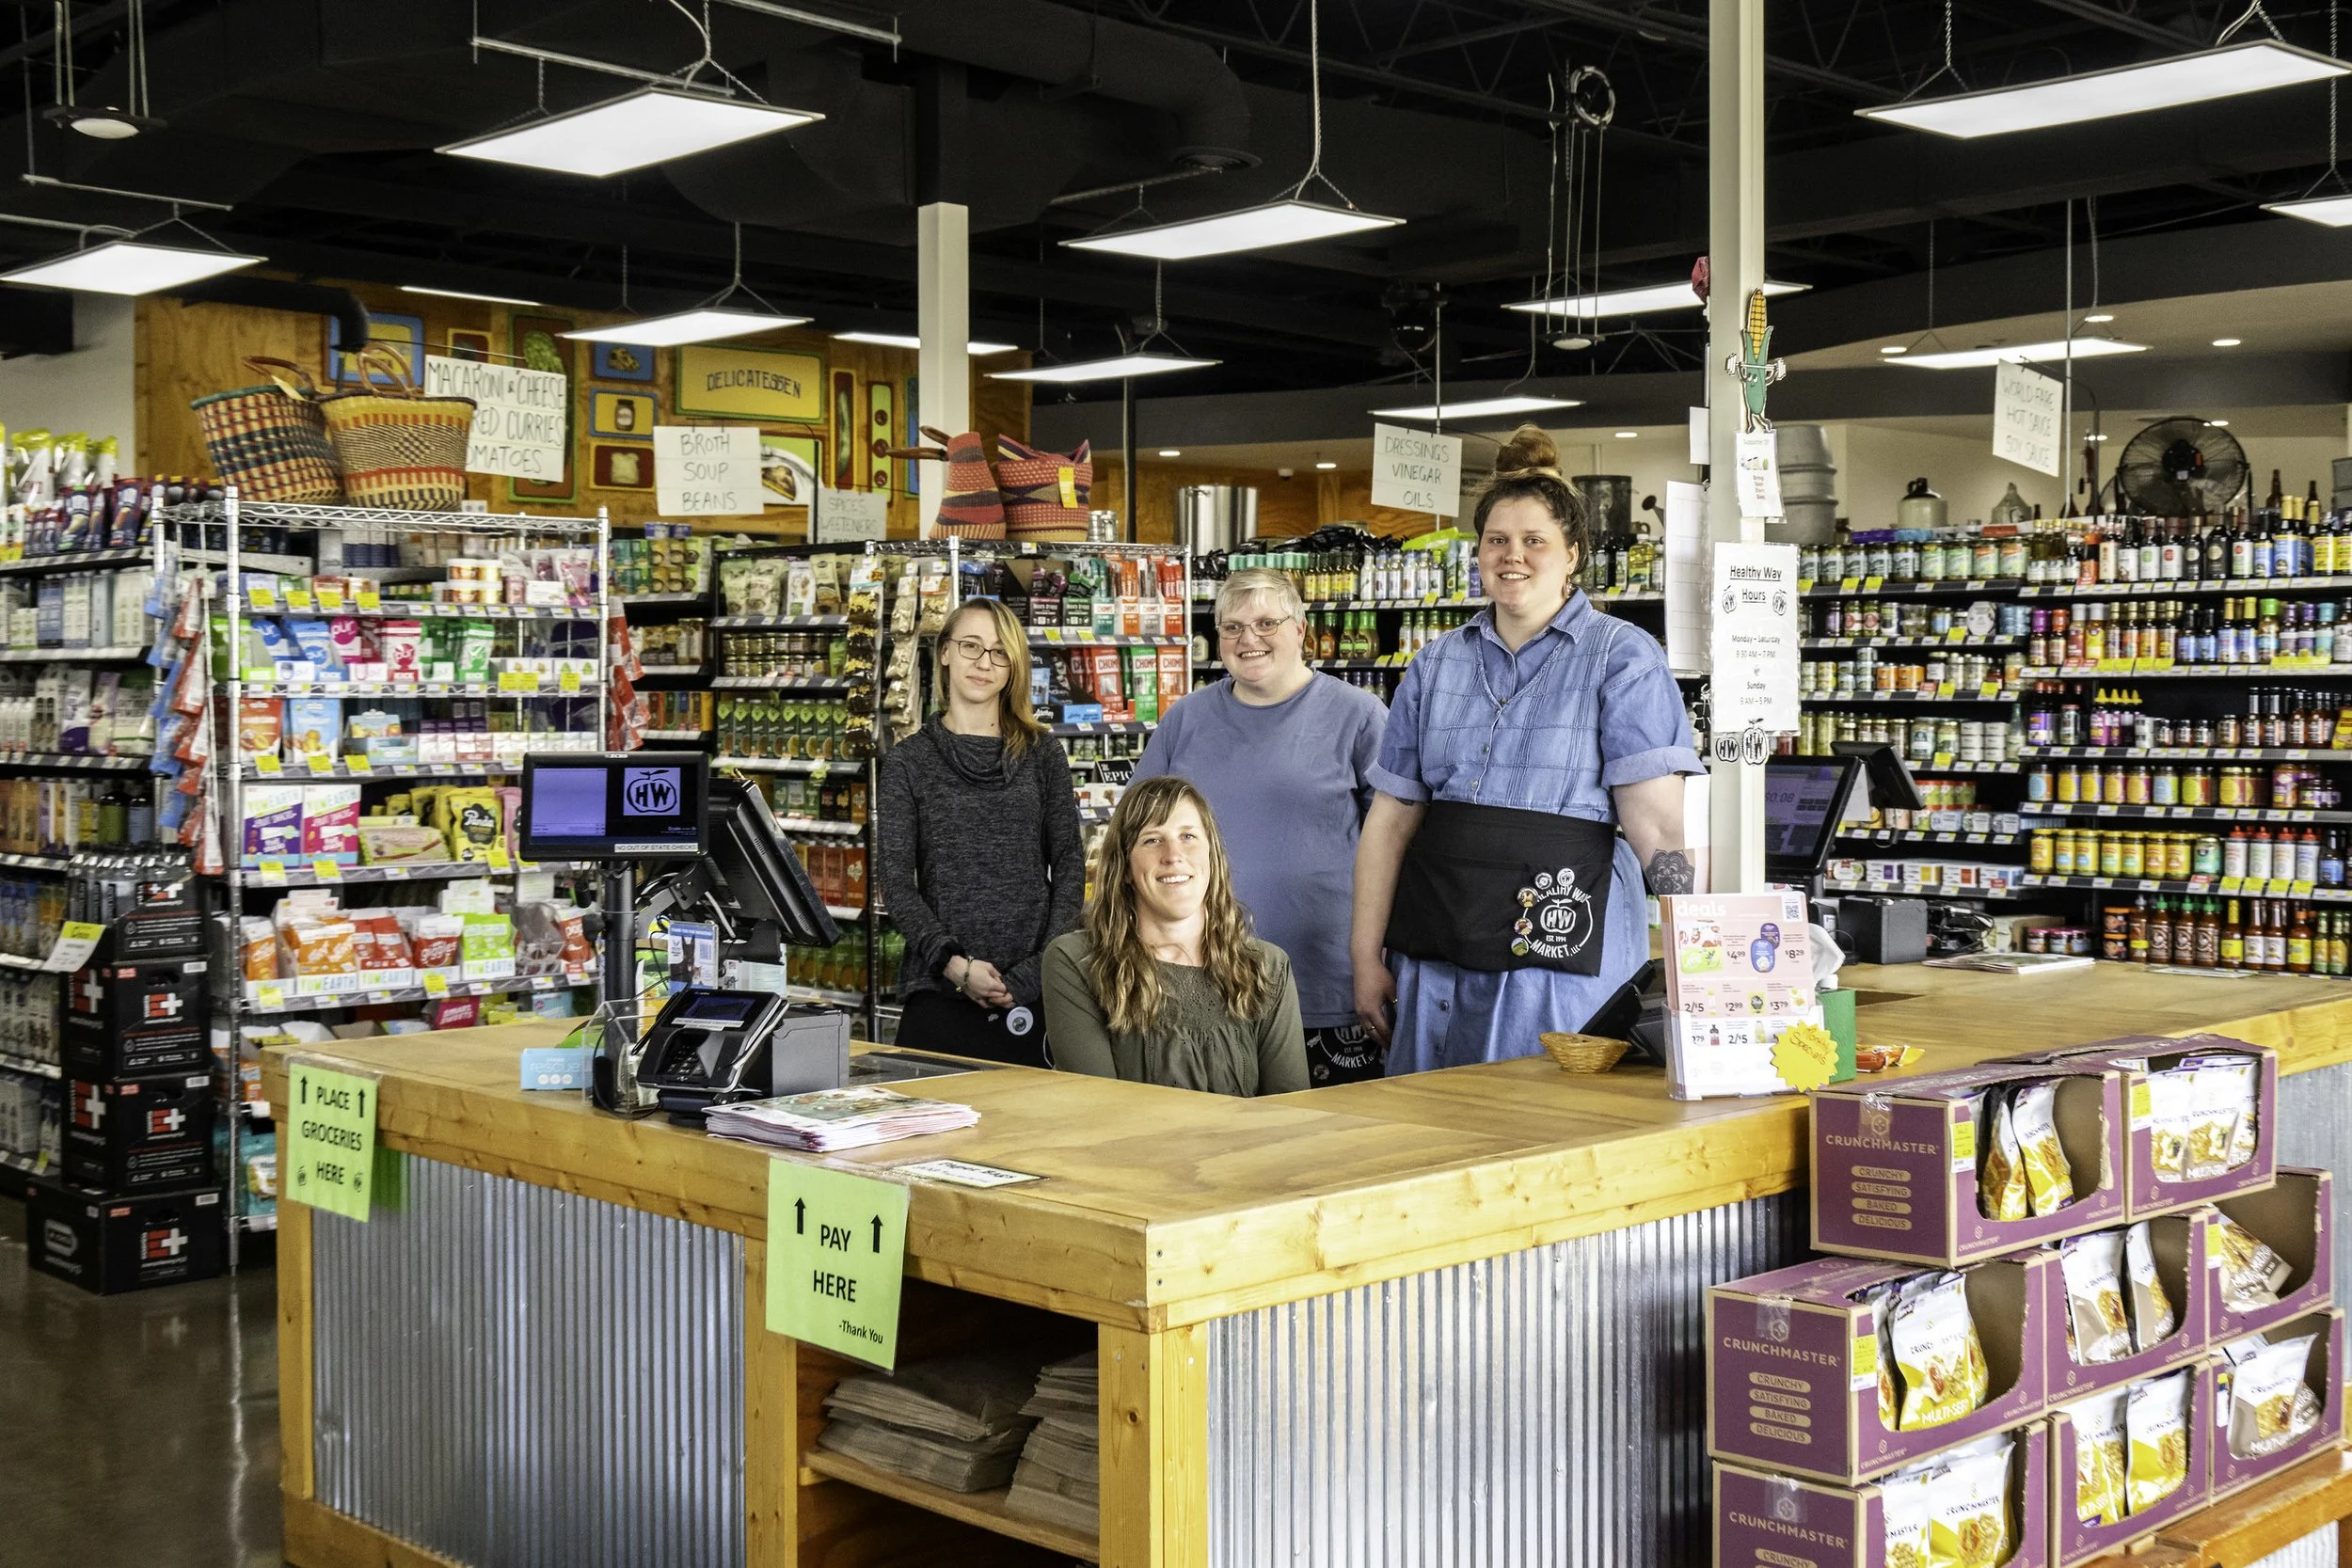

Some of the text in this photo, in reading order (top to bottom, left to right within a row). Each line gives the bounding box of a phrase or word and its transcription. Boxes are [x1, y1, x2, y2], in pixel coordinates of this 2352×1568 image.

[426, 362, 504, 401] MACARONI
[517, 375, 565, 410] CHEESE
[706, 369, 801, 399] DELICATESSEN
[507, 410, 564, 446] CURRIES
[680, 433, 730, 456] BROTH
[1385, 436, 1449, 463] DRESSINGS
[467, 444, 542, 473] OMATOES
[683, 461, 729, 483] SOUP
[1392, 463, 1441, 484] VINEGAR
[682, 491, 737, 512] BEANS
[1403, 490, 1434, 509] OILS
[819, 518, 879, 534] WEETENERS
[1730, 565, 1782, 579] Healthy Way
[1741, 588, 1766, 601] Hours
[1732, 635, 1753, 644] Monday
[1758, 635, 1780, 645] Saturday
[1746, 682, 1766, 690] Sunday
[1720, 738, 1738, 759] HW
[1745, 732, 1764, 760] HW
[1104, 770, 1133, 782] EPIC
[635, 783, 671, 807] HW
[1572, 887, 1592, 903] WAY
[1547, 910, 1572, 928] HW
[1677, 901, 1725, 917] deals
[1789, 1031, 1826, 1065] Specials
[316, 1086, 350, 1110] PLACE
[301, 1120, 362, 1151] GROCERIES
[1825, 1134, 1938, 1155] CRUNCHMASTER
[316, 1161, 344, 1185] HERE
[1859, 1167, 1904, 1180] CRUNCHY
[1855, 1184, 1908, 1196] SATISFYING
[1867, 1201, 1898, 1212] BAKED
[1858, 1215, 1906, 1228] DELICIOUS
[820, 1224, 850, 1252] PAY
[813, 1270, 856, 1303] HERE
[869, 1329, 883, 1344] You
[1723, 1337, 1837, 1367] CRUNCHMASTER
[1757, 1374, 1804, 1390] CRUNCHY
[1754, 1391, 1807, 1408] SATISFYING
[1764, 1409, 1797, 1423] BAKED
[1756, 1424, 1805, 1442] DELICIOUS
[1728, 1511, 1846, 1549] CRUNCHMASTER
